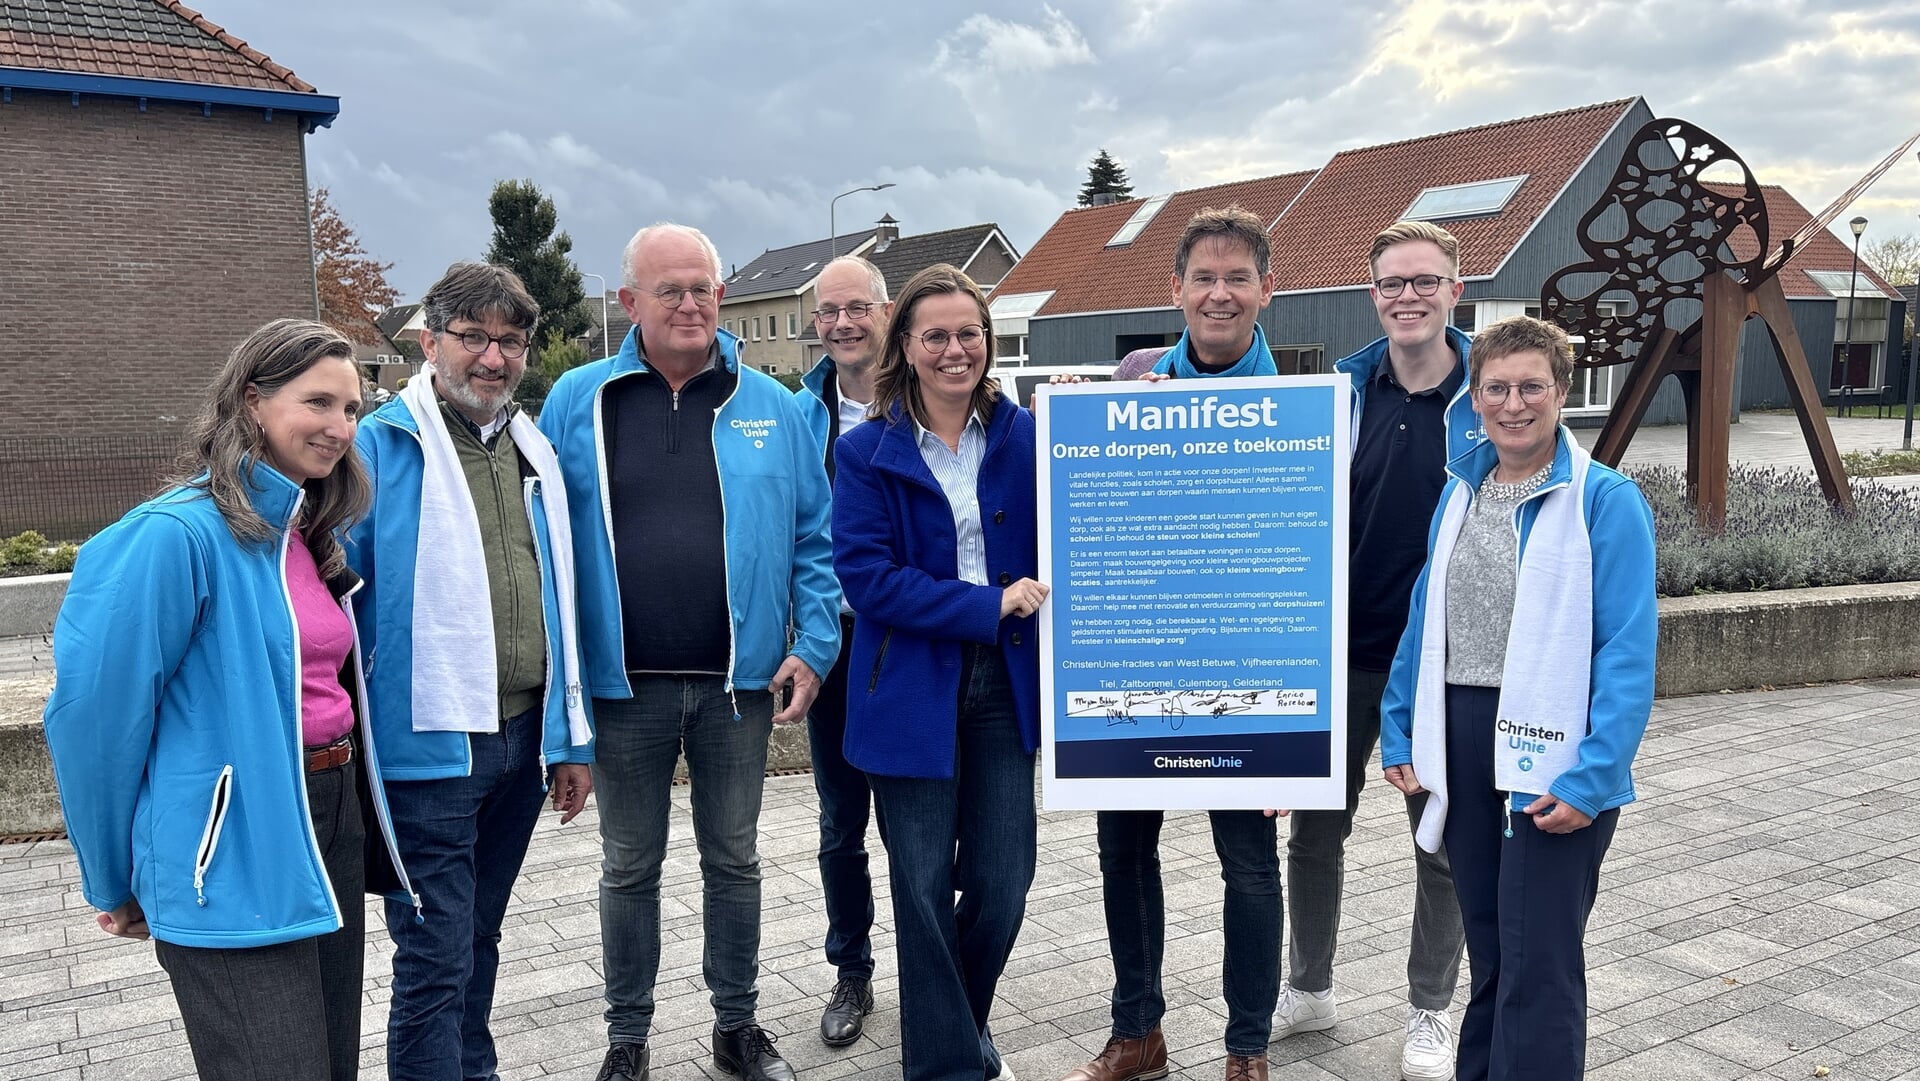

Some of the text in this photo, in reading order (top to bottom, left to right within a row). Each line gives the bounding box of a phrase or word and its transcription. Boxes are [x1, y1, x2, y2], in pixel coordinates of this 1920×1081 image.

[1107, 396, 1278, 431] Manifest
[730, 418, 777, 429] Christen
[742, 427, 769, 438] Unie
[1053, 435, 1330, 459] Onze dorpen, onze toekomst!
[1069, 471, 1106, 480] Landelijke
[1164, 469, 1181, 477] actie
[1202, 468, 1220, 476] onze
[1253, 466, 1287, 474] Investeer
[1122, 479, 1142, 487] zoals
[1176, 479, 1193, 487] zorg
[1255, 476, 1280, 484] Alleen
[1157, 489, 1183, 497] dorpen
[1273, 486, 1296, 494] blijven
[1070, 516, 1081, 525] Wij
[1174, 514, 1197, 522] goede
[1200, 523, 1220, 531] nodig
[1125, 559, 1186, 567] bouwregelgeving
[1230, 556, 1311, 565] woningbouwprojecten
[1071, 595, 1082, 603] Wij
[1159, 593, 1182, 601] blijven
[1104, 604, 1119, 612] help
[1114, 619, 1130, 627] zorg
[1251, 616, 1294, 624] regelgeving
[1071, 629, 1115, 637] geldstromen
[1220, 626, 1252, 634] Bijsturen
[1114, 637, 1165, 645] kleinschalige
[1062, 660, 1155, 669] ChristenUnie-fracties
[1176, 659, 1200, 667] West
[1202, 659, 1238, 667] Betuwe,
[1242, 658, 1320, 668] Vijfheerenlanden,
[1099, 678, 1283, 689] Tiel, Zaltbommel, Culemborg, Gelderland
[1497, 719, 1565, 742] Christen
[1508, 735, 1546, 754] Unie
[1154, 756, 1243, 768] ChristenUnie
